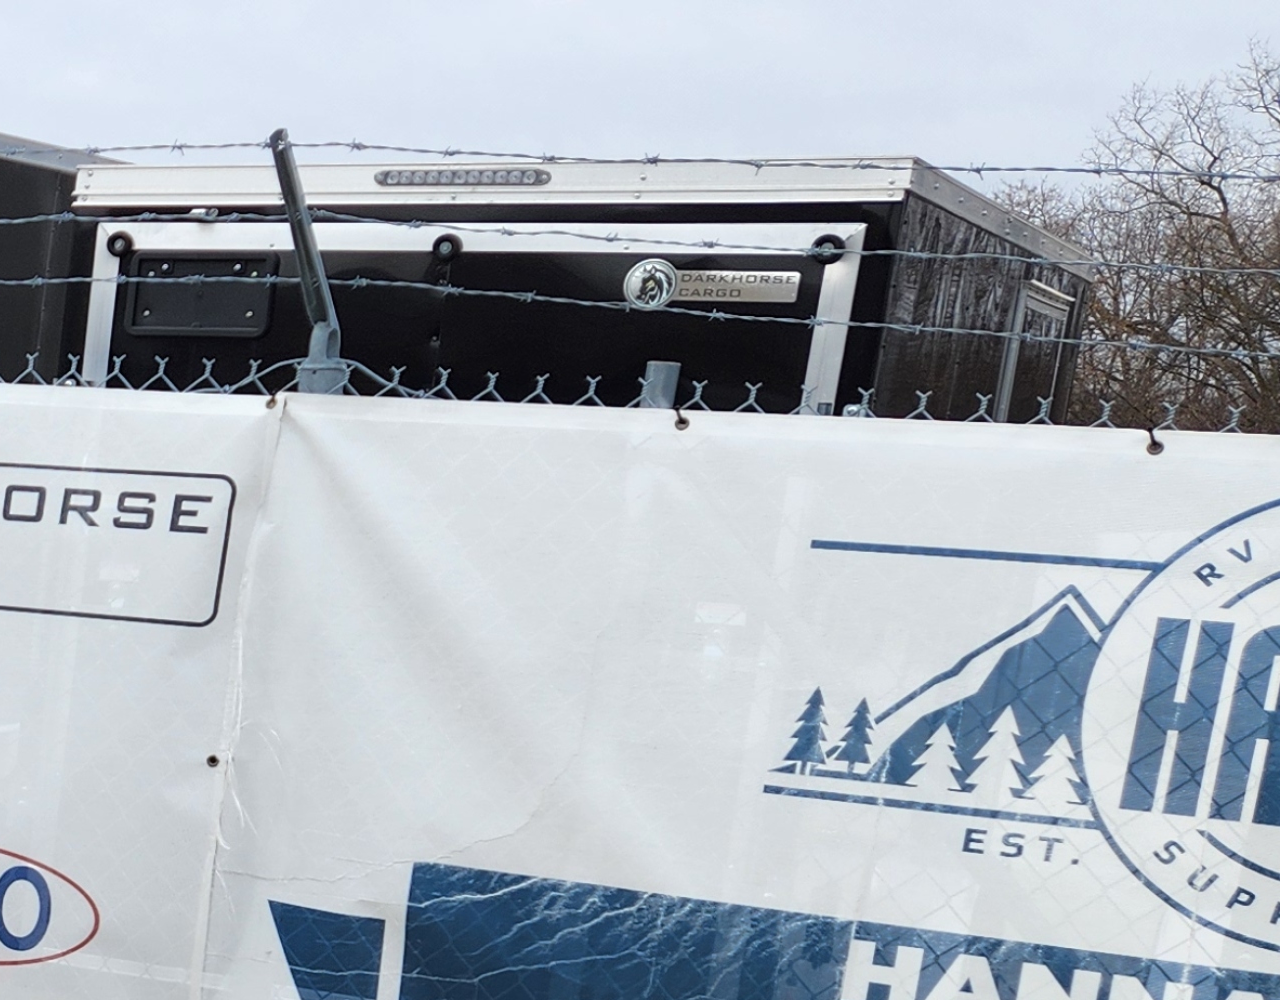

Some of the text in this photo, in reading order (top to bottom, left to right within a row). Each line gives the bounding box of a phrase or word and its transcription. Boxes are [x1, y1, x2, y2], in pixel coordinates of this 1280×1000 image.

[680, 273, 797, 285] DARKHORSE
[678, 288, 741, 298] CARGO
[1193, 538, 1253, 587] RV
[961, 827, 1079, 866] EST.
